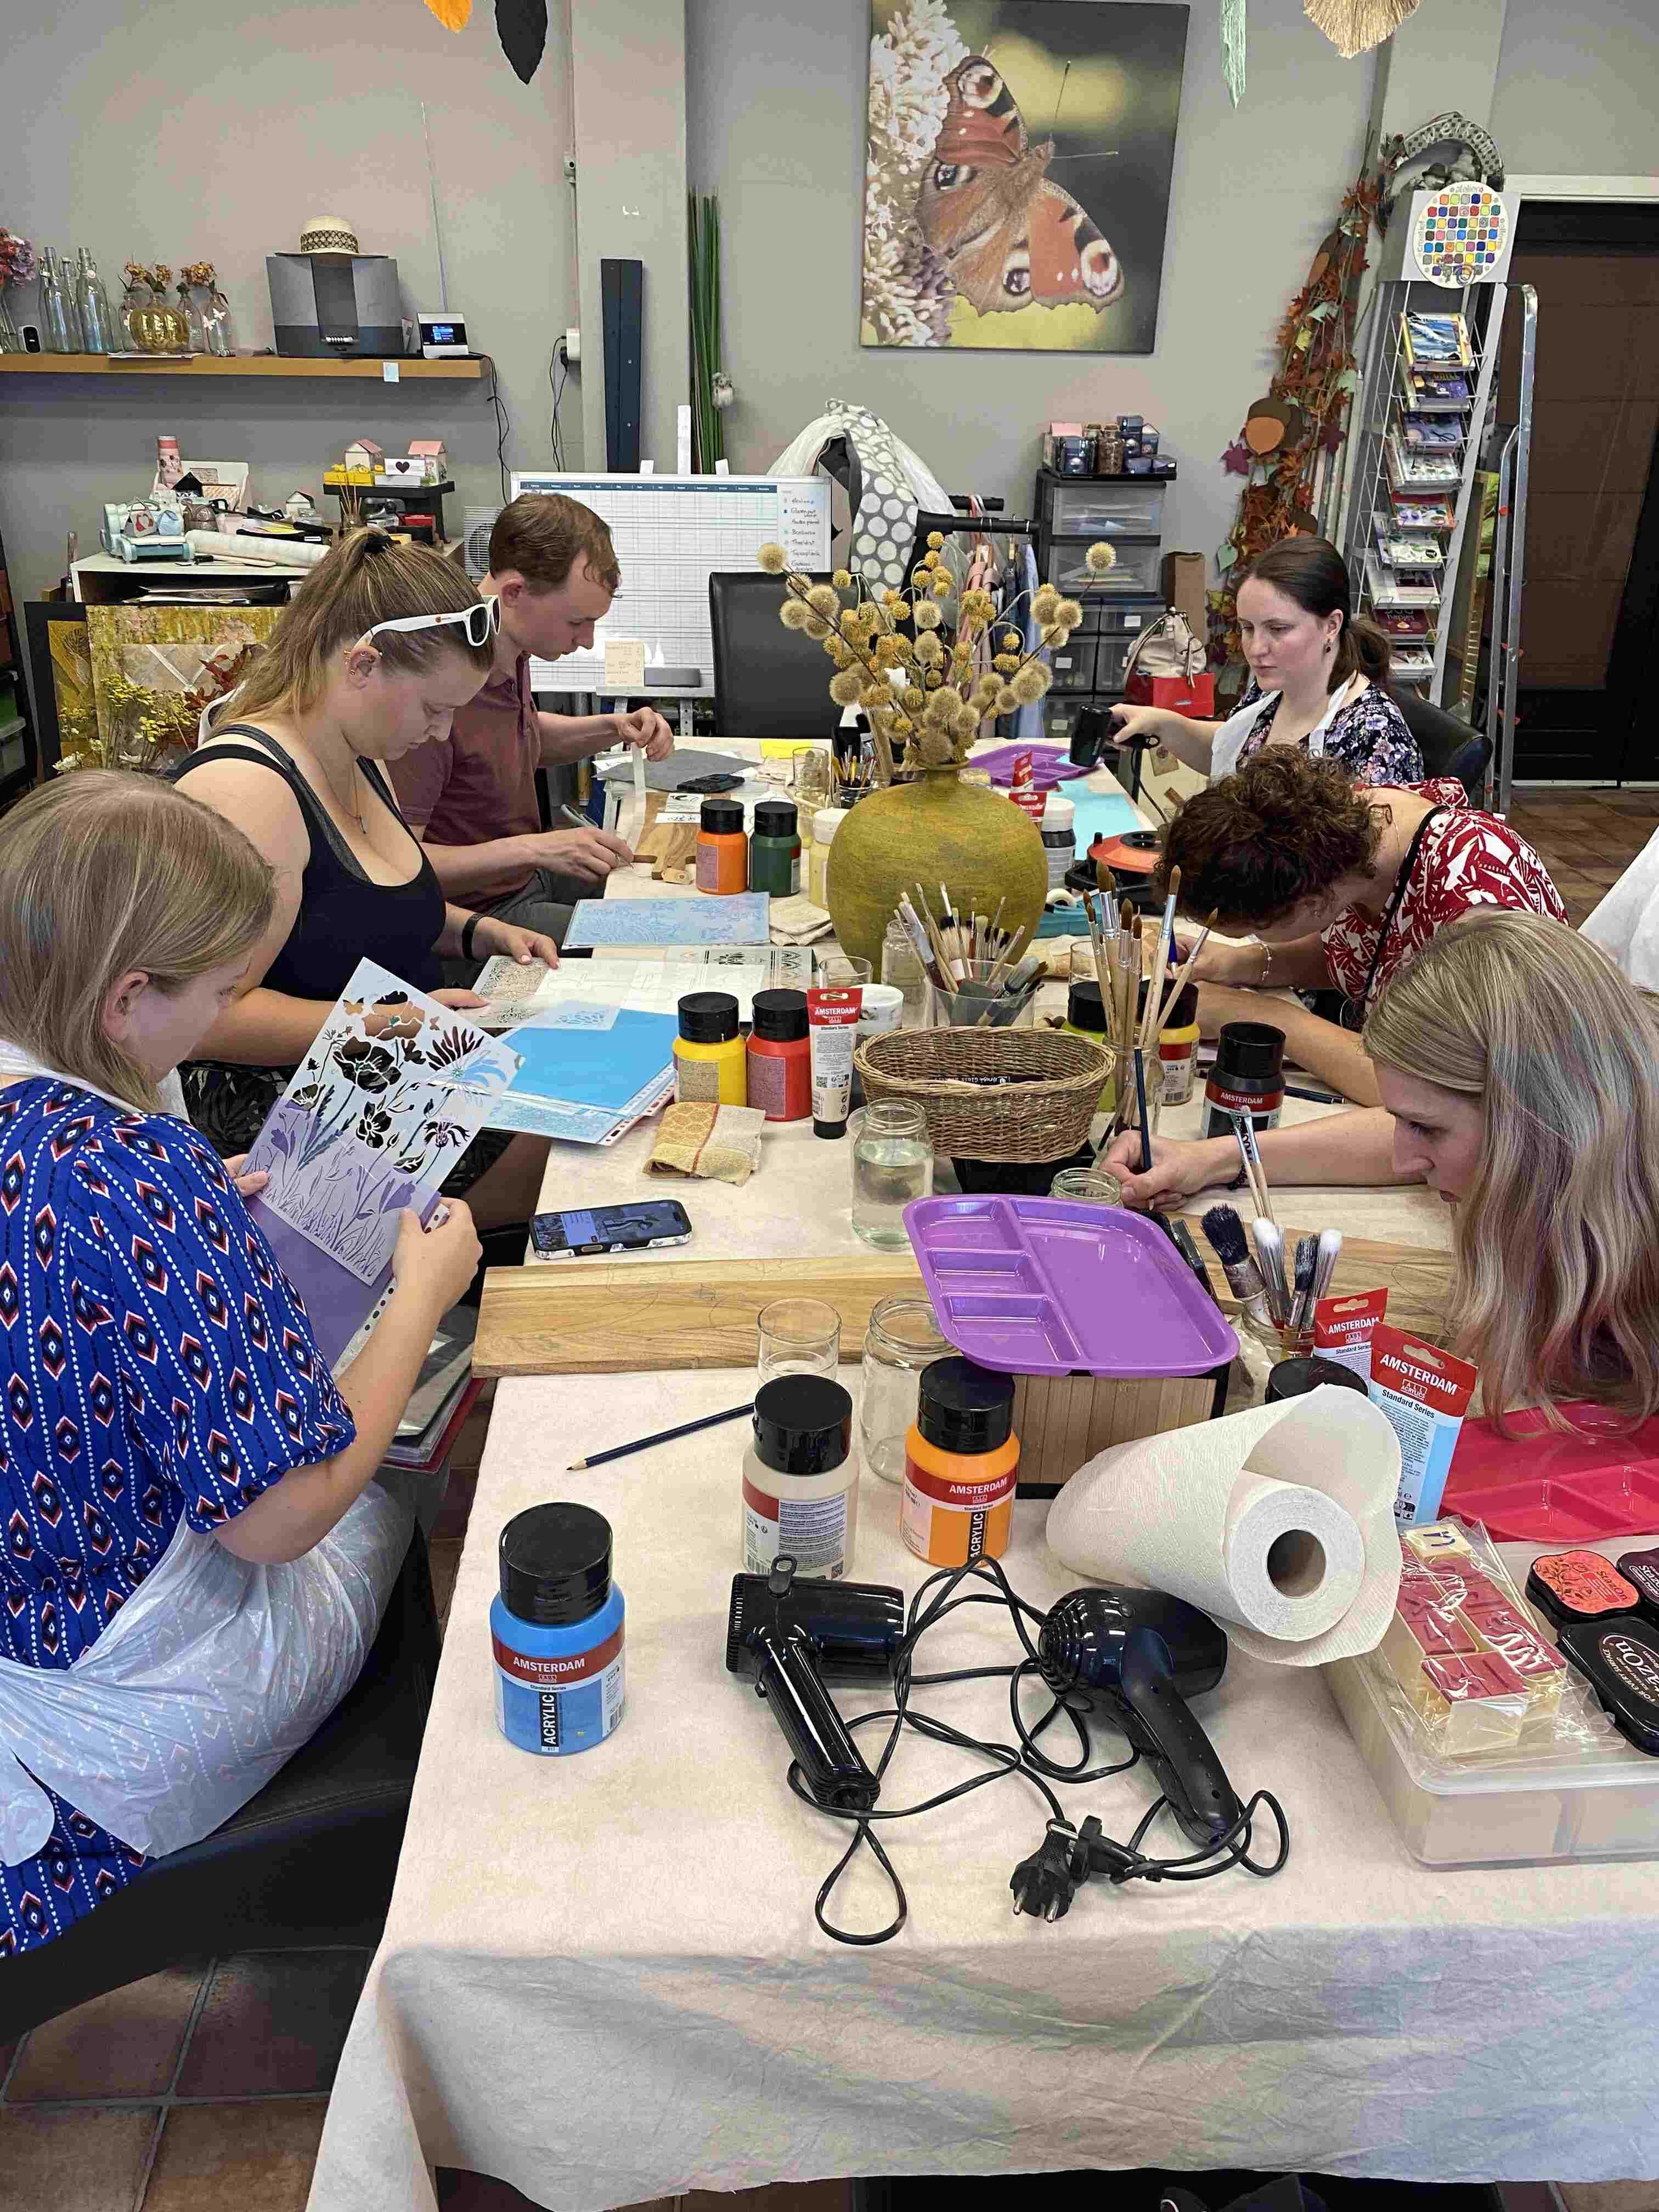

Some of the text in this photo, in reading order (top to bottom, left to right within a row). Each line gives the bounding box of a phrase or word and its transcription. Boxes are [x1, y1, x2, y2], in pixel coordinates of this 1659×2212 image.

[815, 1007, 857, 1015] AMSTERDAM
[1221, 1092, 1263, 1104] AMSTERDAM
[1328, 1316, 1379, 1335] AMSTERDAM
[1335, 1346, 1357, 1355] Standard
[1380, 1353, 1458, 1396] AMSTERDAM
[1382, 1389, 1435, 1418] Standard Series
[949, 1477, 1007, 1494] AMSTERDAM
[1596, 1571, 1628, 1600] StazOn
[514, 1657, 585, 1673] AMSTERDAM
[1602, 1648, 1655, 1702] FOR EVERY SURFACE
[542, 1694, 556, 1745] ACRYLIC
